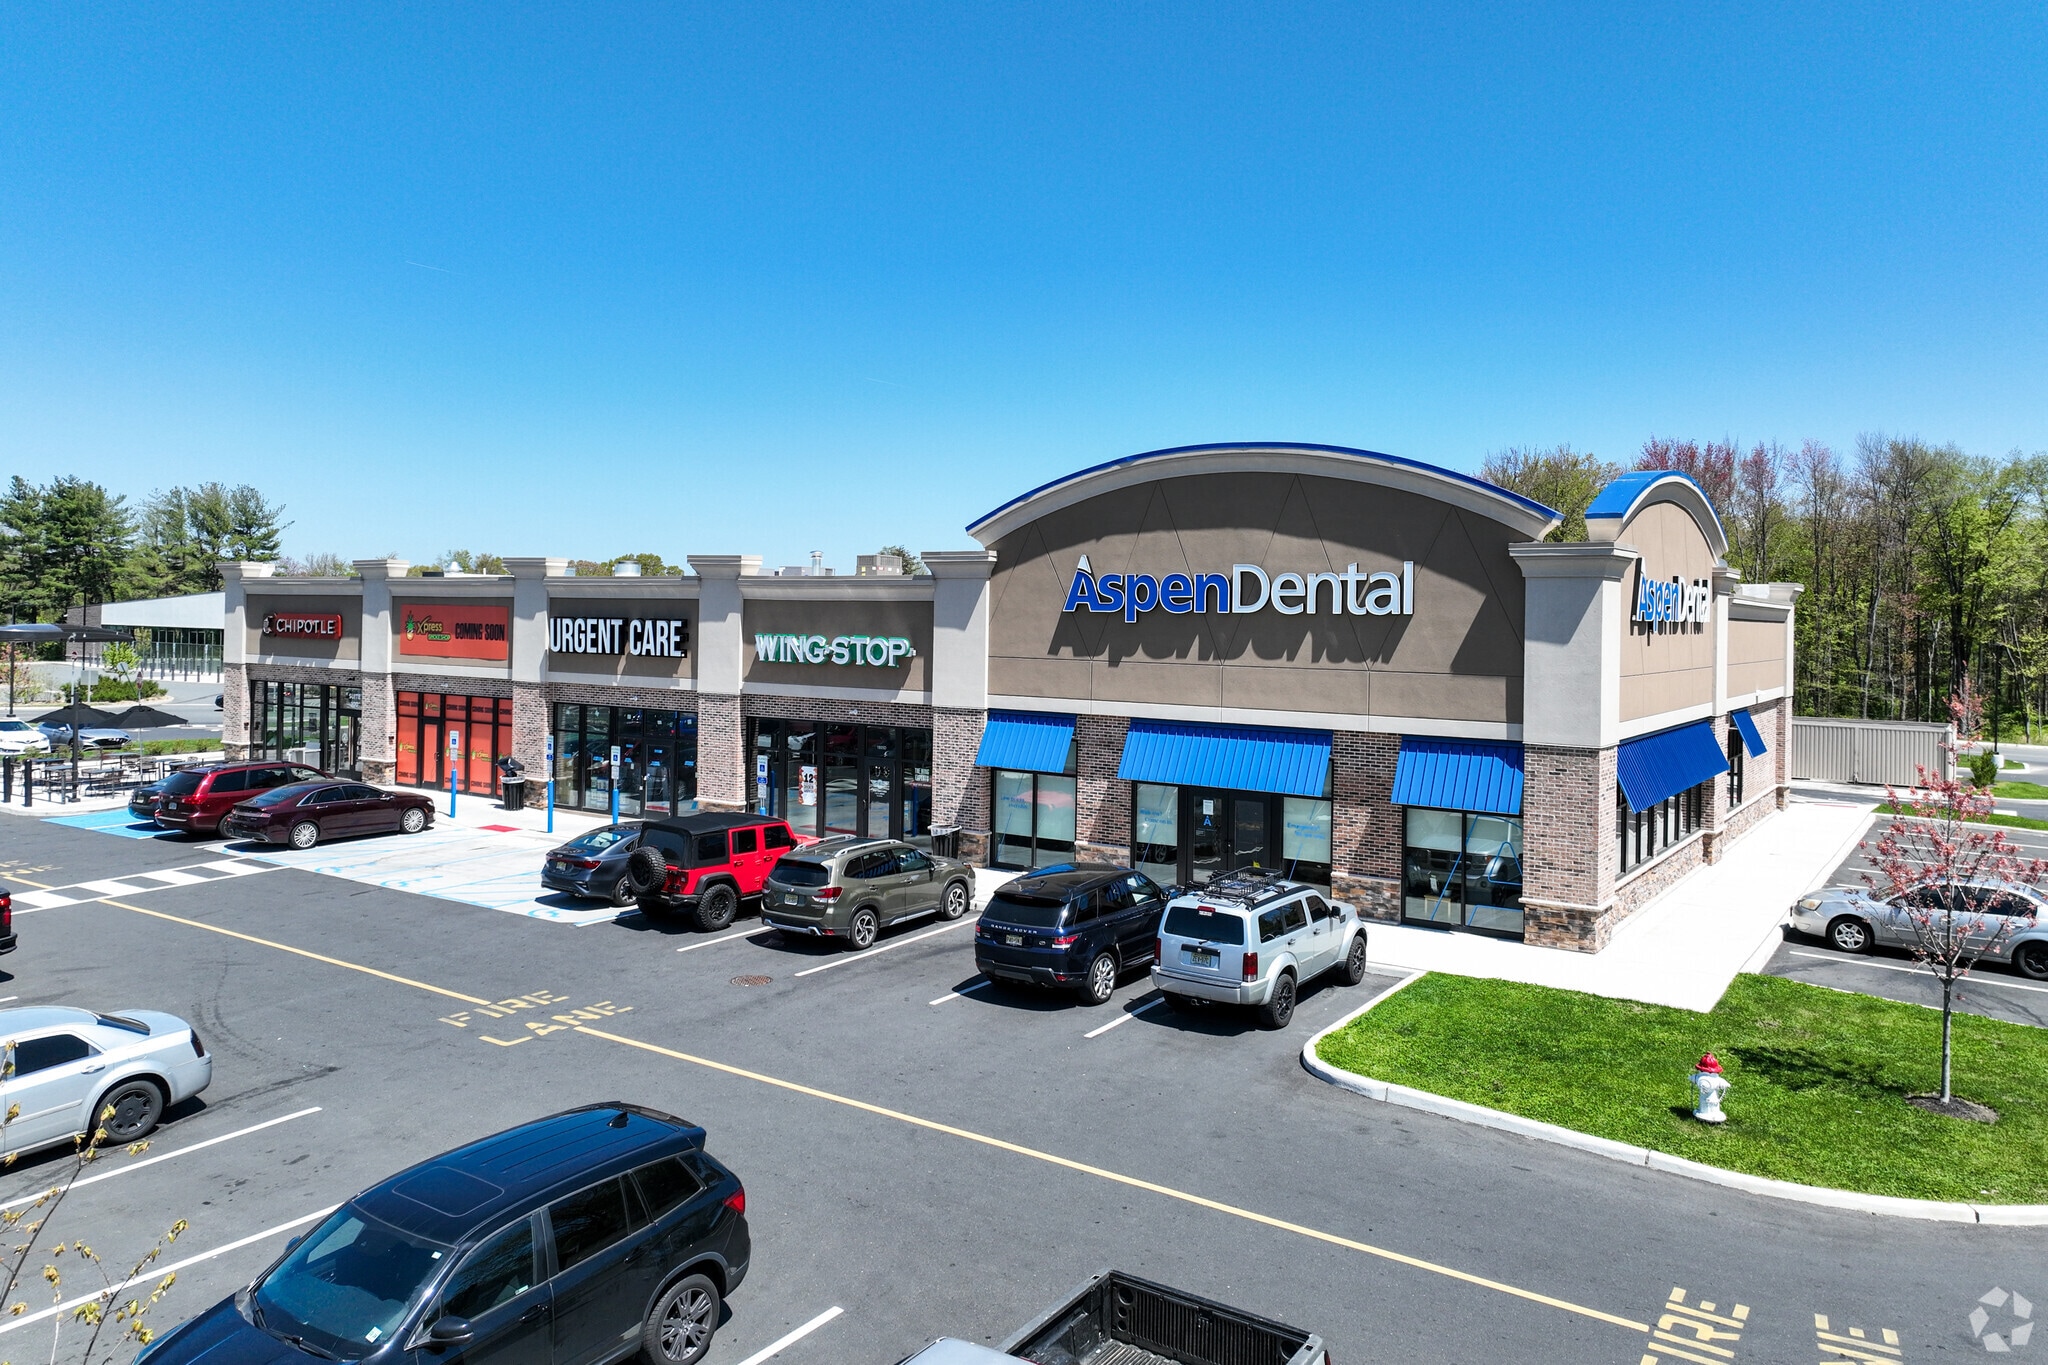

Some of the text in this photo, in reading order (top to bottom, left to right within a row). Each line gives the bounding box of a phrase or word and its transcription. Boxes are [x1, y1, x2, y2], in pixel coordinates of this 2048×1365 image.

[1062, 554, 1414, 623] AspenDental
[276, 618, 335, 634] CHIPOTLE
[416, 615, 443, 634] Xpress
[455, 623, 505, 641] COMING SOON
[550, 618, 623, 654] URGENT
[804, 773, 814, 783] 12
[438, 990, 570, 1028] FIRE
[478, 1001, 634, 1047] LANE
[1640, 1286, 1750, 1365] IRE
